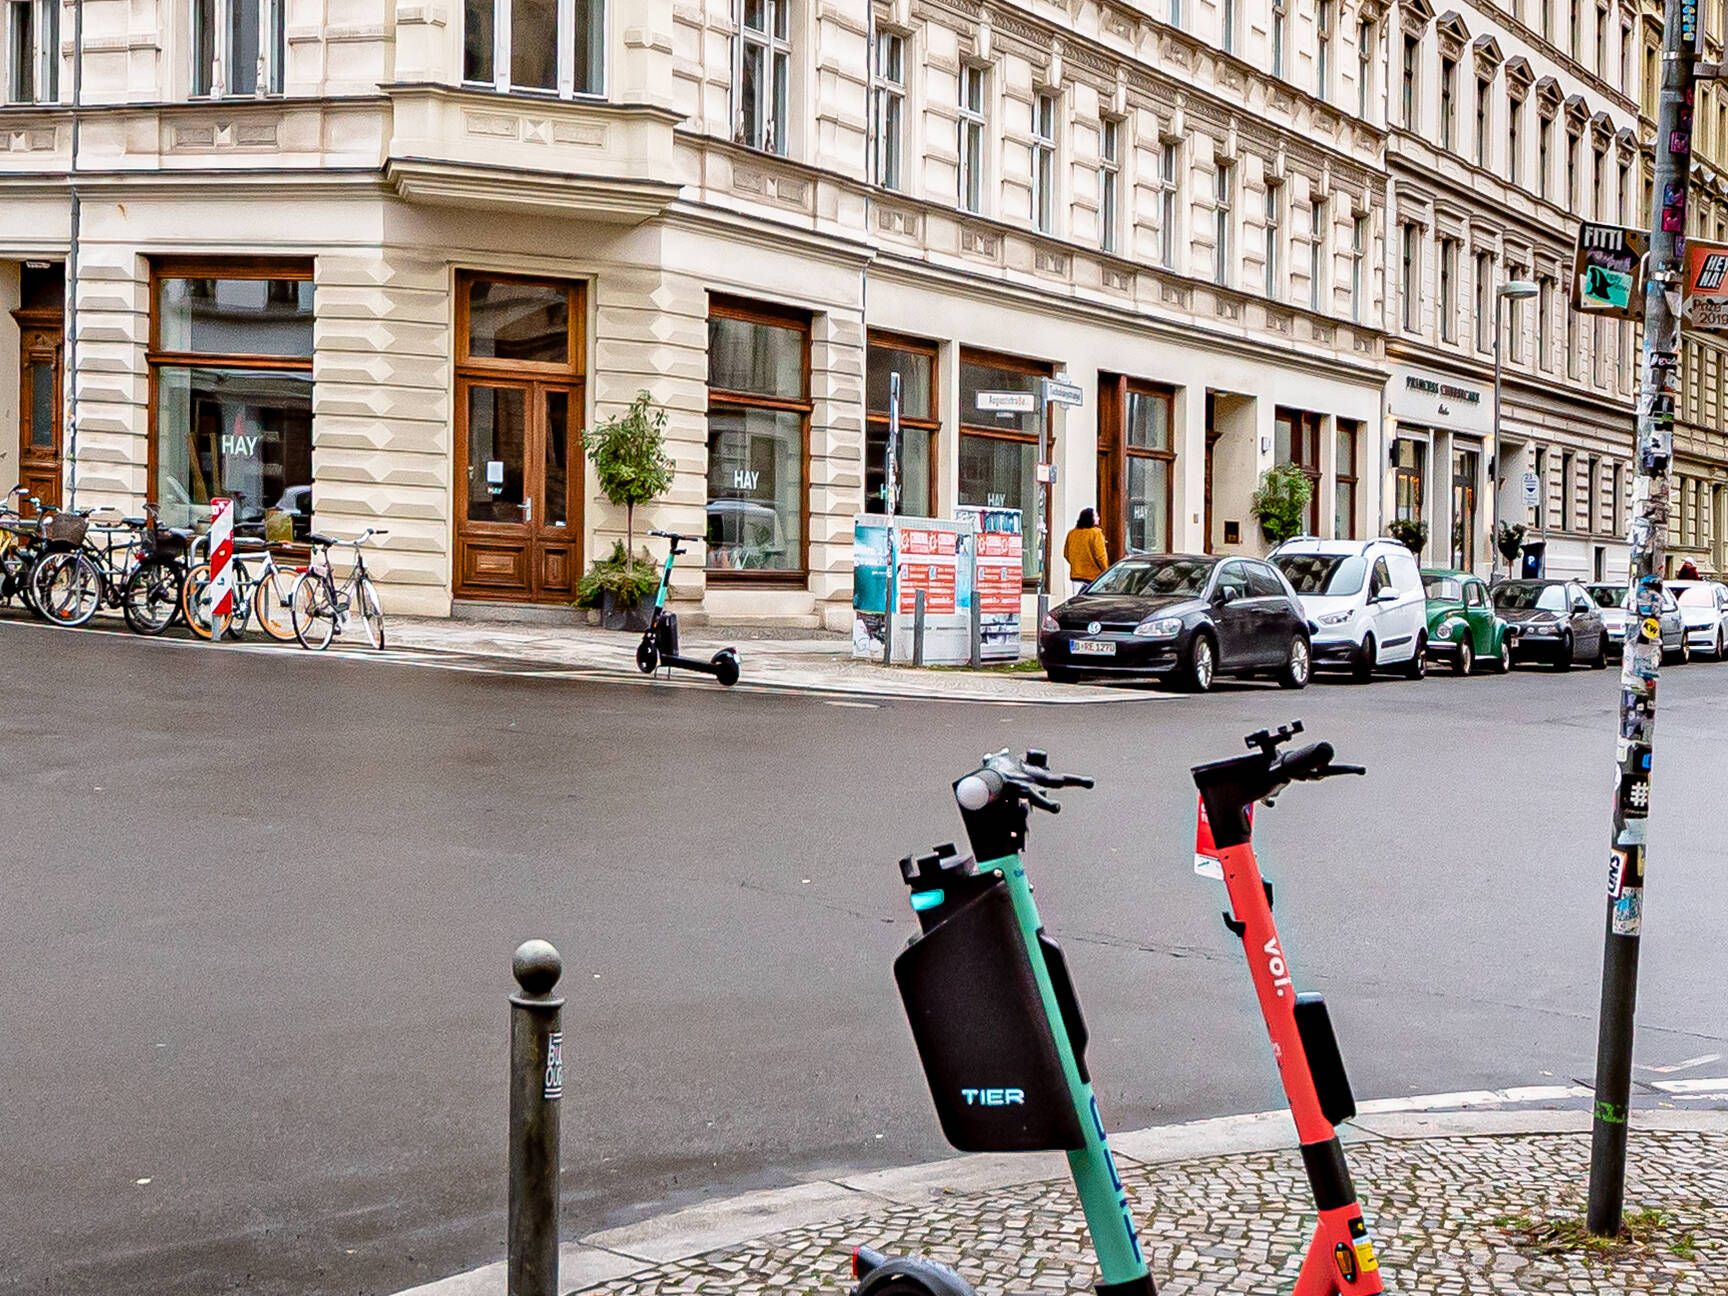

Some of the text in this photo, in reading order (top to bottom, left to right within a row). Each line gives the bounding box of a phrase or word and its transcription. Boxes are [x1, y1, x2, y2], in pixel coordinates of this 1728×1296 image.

[222, 434, 258, 456] HAY
[734, 469, 760, 490] HAY
[880, 483, 902, 502] HY
[987, 492, 1007, 507] HAY
[1527, 555, 1536, 566] P
[961, 1088, 1025, 1106] TIER
